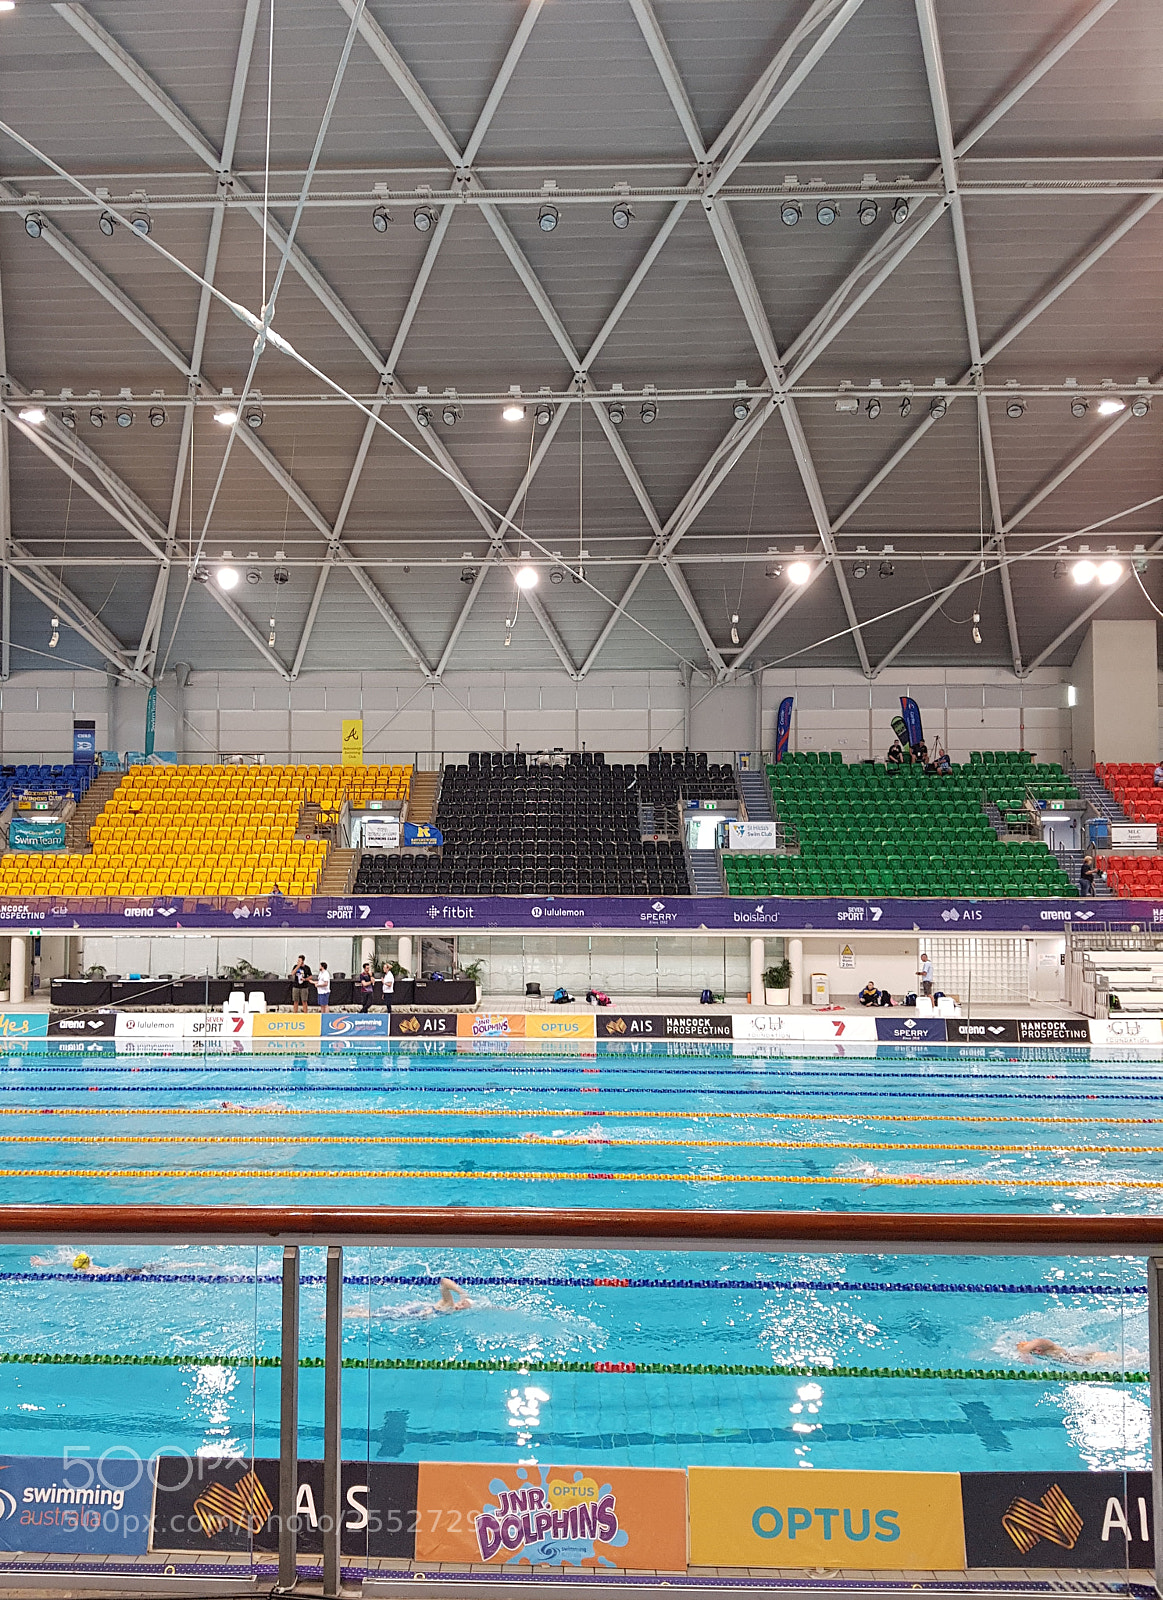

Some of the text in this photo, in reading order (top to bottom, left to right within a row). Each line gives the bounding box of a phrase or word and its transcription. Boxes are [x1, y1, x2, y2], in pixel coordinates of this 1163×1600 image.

[14, 834, 62, 845] Swim Team
[124, 907, 154, 917] arena
[253, 907, 272, 917] AIS
[326, 910, 353, 919] SPORT
[442, 905, 474, 919] fitbit
[544, 907, 585, 917] lululemon
[640, 913, 678, 921] SPERRY
[837, 911, 864, 921] SPORT
[962, 909, 983, 920] AIS
[1040, 910, 1072, 920] arena
[59, 1020, 86, 1029] arena
[137, 1020, 175, 1029] lululemon
[192, 1022, 224, 1033] SPORT
[231, 1017, 245, 1033] 7
[267, 1022, 306, 1031] OPTUS
[423, 1019, 446, 1031] AIS
[541, 1023, 579, 1032] OPTUS
[630, 1020, 653, 1032] AIS
[666, 1018, 711, 1027] HANCOCK
[1020, 1022, 1067, 1031] HANCOCK
[472, 1020, 509, 1036] DOLPHINS
[666, 1026, 730, 1035] PROSPECTING
[831, 1020, 846, 1036] 7
[893, 1029, 929, 1037] SPERRY
[958, 1025, 985, 1035] arena
[1021, 1029, 1087, 1039] PROSPECTING
[22, 1483, 125, 1510] swimming
[552, 1486, 595, 1498] OPTUS
[295, 1483, 371, 1529] AS
[19, 1505, 102, 1528] australia
[475, 1494, 619, 1562] DOLPHINS
[751, 1506, 901, 1543] OPTUS
